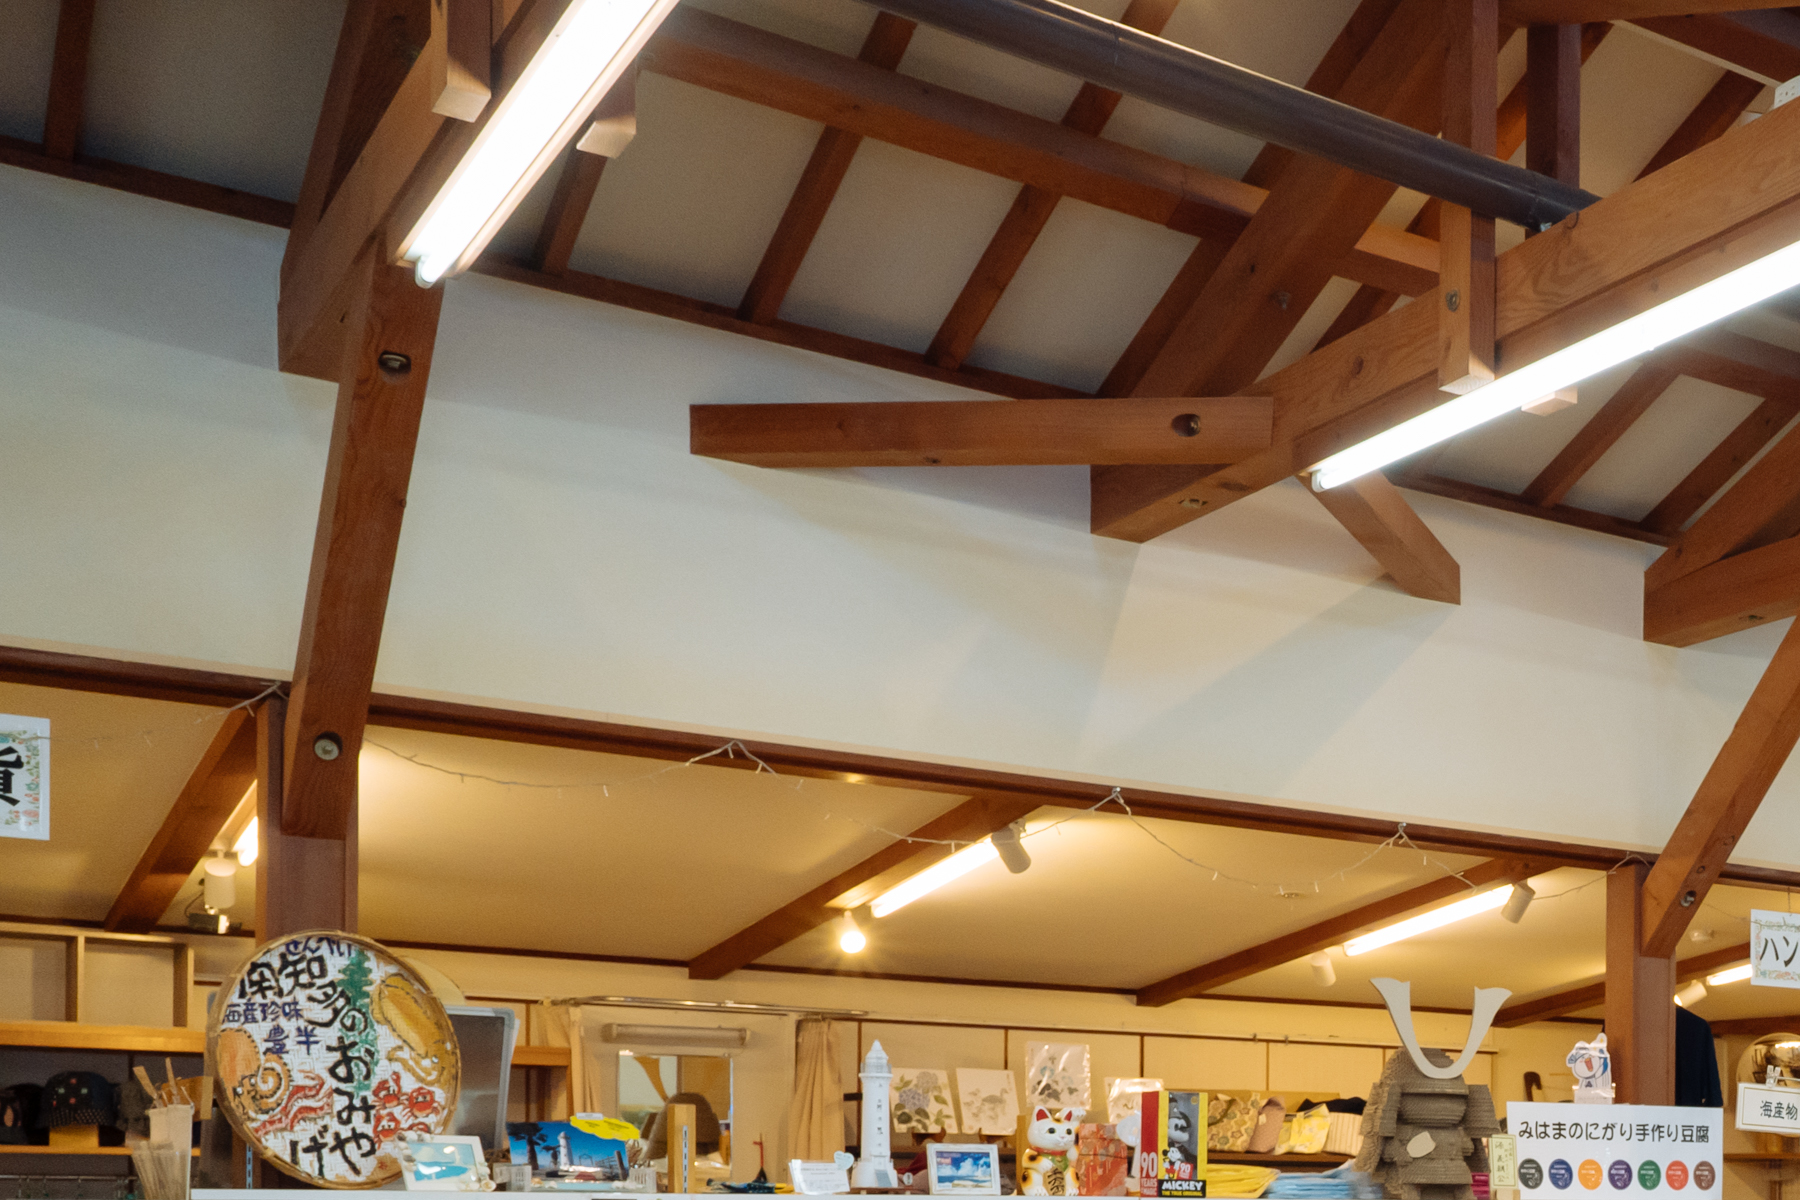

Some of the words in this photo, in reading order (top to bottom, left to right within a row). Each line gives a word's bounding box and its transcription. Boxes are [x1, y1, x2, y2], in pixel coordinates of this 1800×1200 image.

[1518, 1121, 1710, 1143] みはまのにがり手作り豆腐
[1141, 1152, 1157, 1177] 90
[1161, 1181, 1203, 1191] MICKEY
